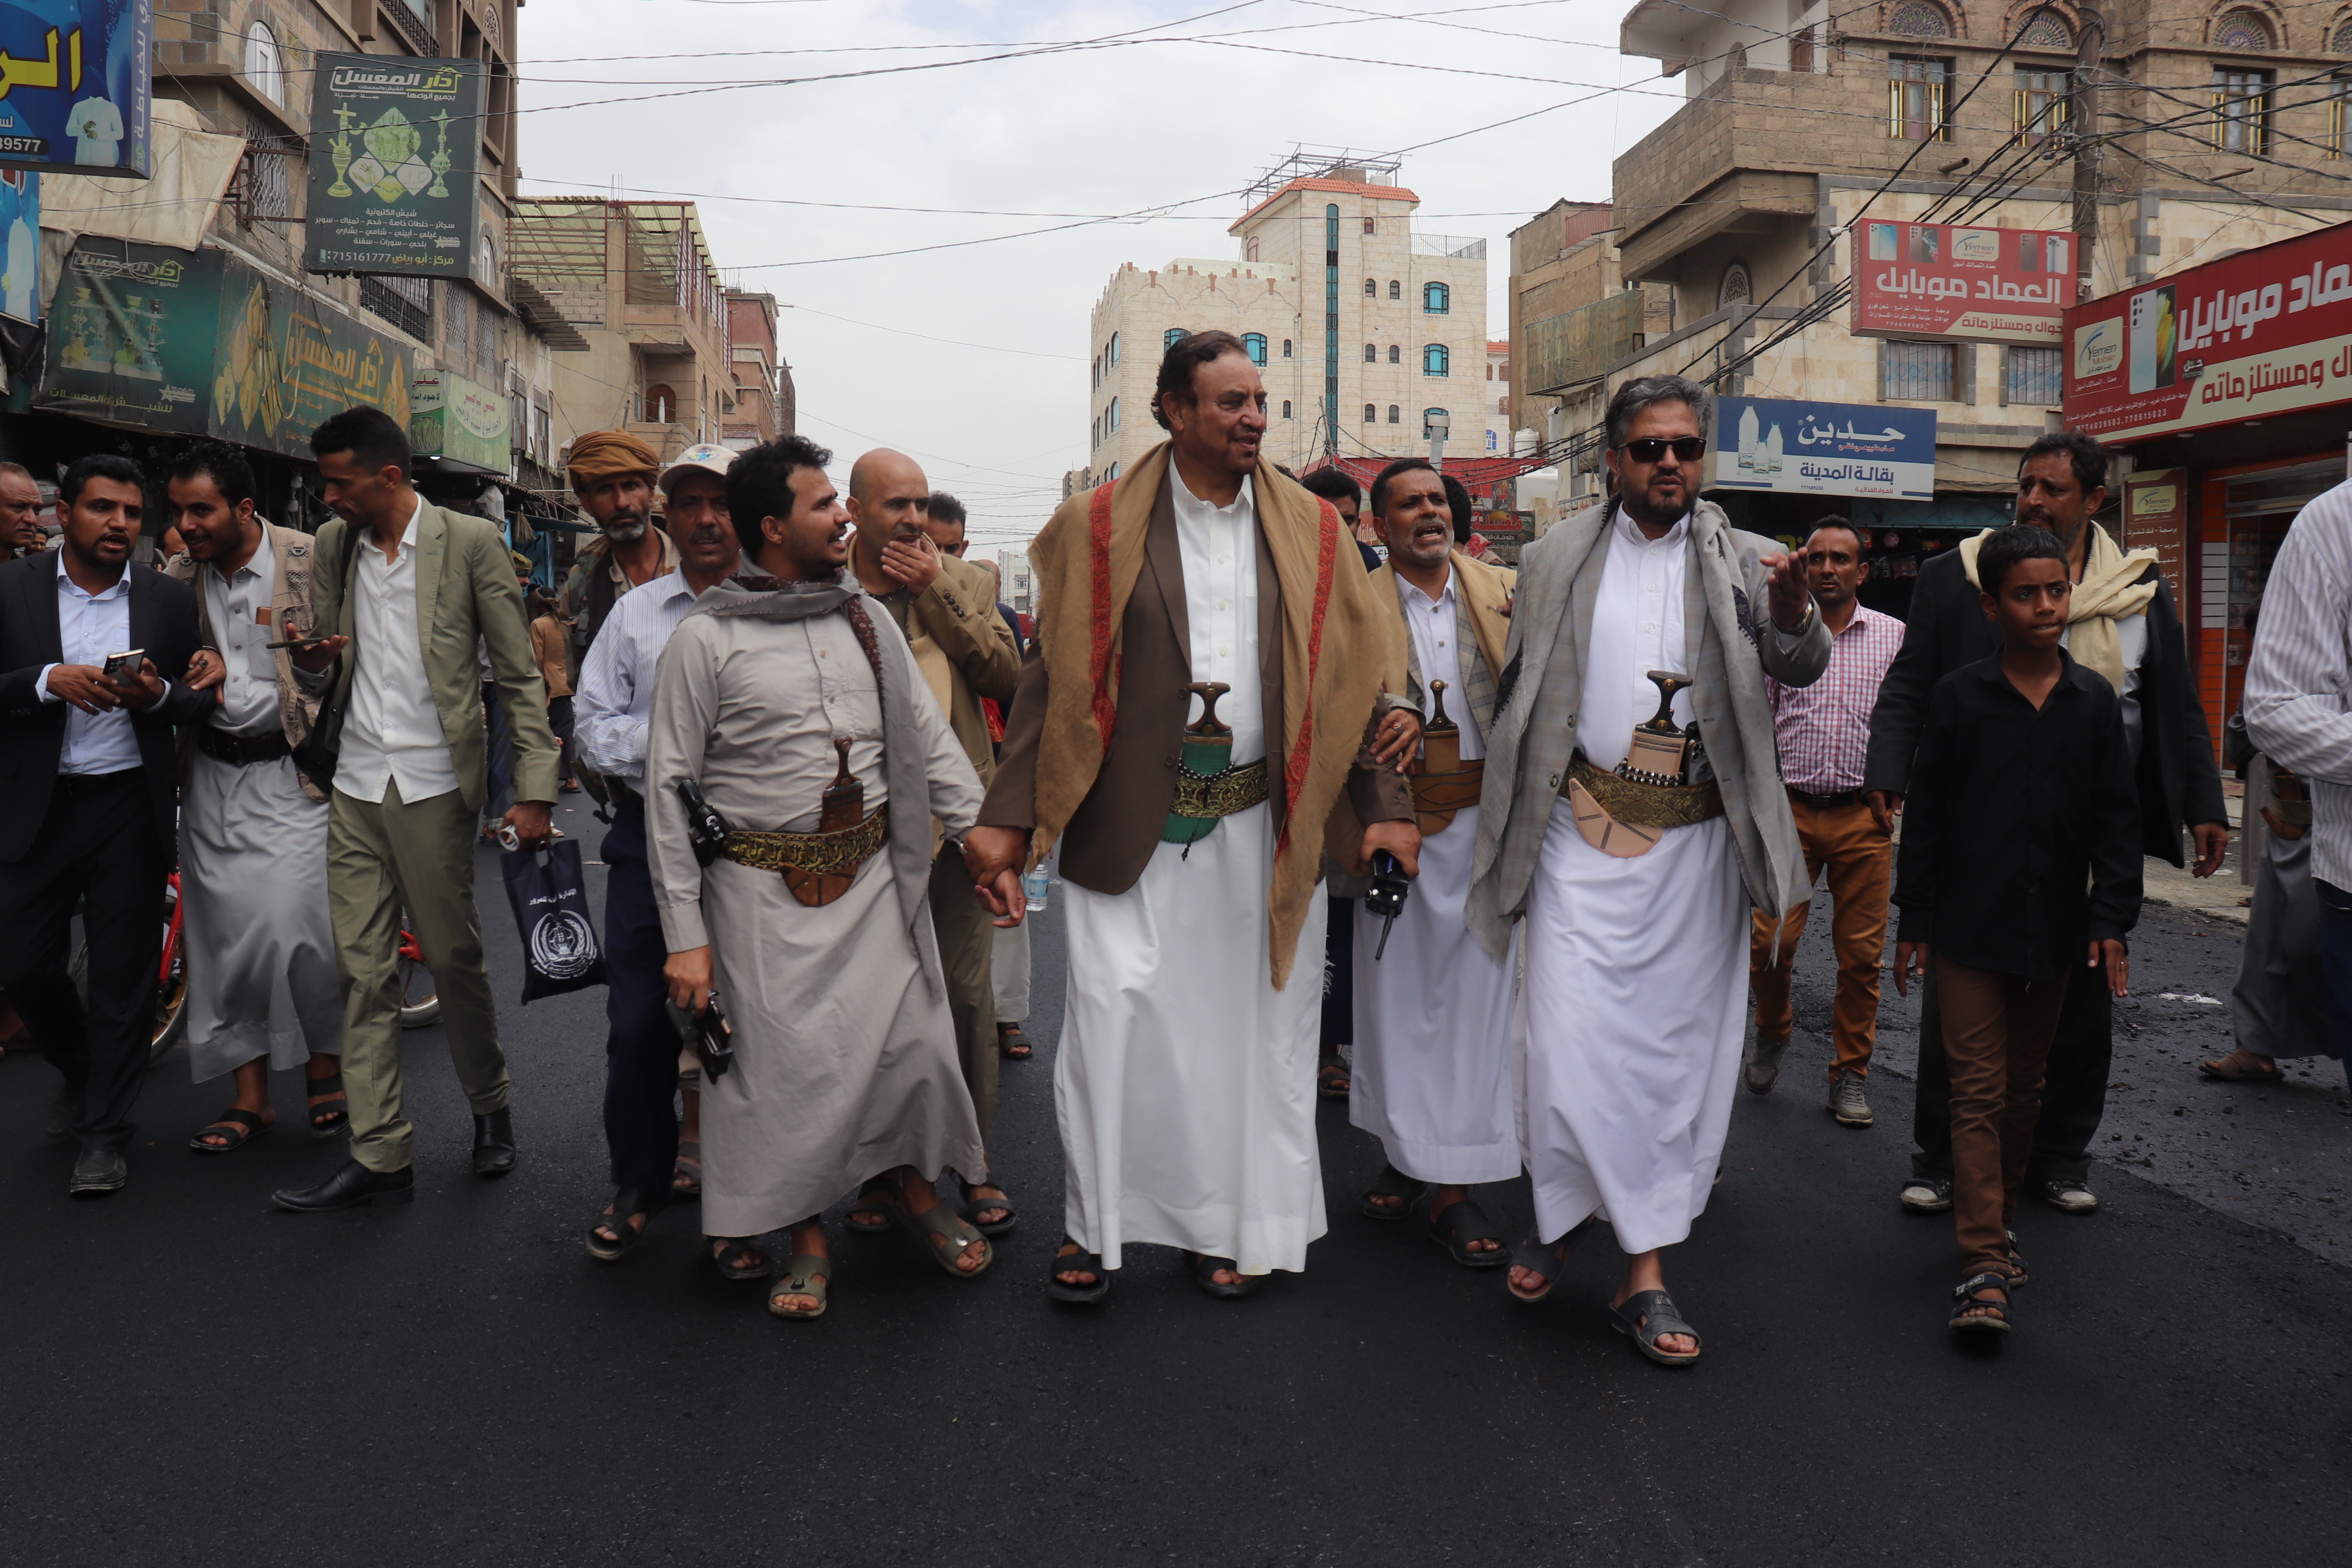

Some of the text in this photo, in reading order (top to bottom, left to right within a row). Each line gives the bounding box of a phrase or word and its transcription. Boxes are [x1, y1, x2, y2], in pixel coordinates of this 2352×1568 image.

[134, 30, 148, 139] للخياطة
[335, 70, 453, 89] دار المعسل
[433, 93, 456, 102] بجميع
[365, 208, 417, 217] شيش الكترونية
[407, 220, 429, 228] خلطات
[435, 221, 455, 230] سجائر
[364, 227, 387, 236] شامي
[409, 240, 427, 249] بلحي
[1964, 241, 1994, 251] Yemen
[391, 254, 413, 265] رياض
[415, 252, 428, 264] أبو
[433, 255, 454, 265] مركز
[150, 266, 176, 277] دار
[1876, 266, 2060, 304] العماد موبايل
[2177, 283, 2283, 352] موبايل
[2088, 344, 2117, 360] Yemen
[288, 326, 377, 390] دار المعسل
[2093, 355, 2115, 365] Mobile
[2202, 359, 2324, 405] ومستلزماته
[50, 388, 172, 413] للشيش والمعسلات
[1798, 414, 1906, 445] حدين
[1838, 442, 1854, 450] نقي
[1854, 443, 1880, 452] طبيعي
[1800, 462, 1894, 485] بقالة المدينة
[1471, 511, 1523, 531] مغسلة
